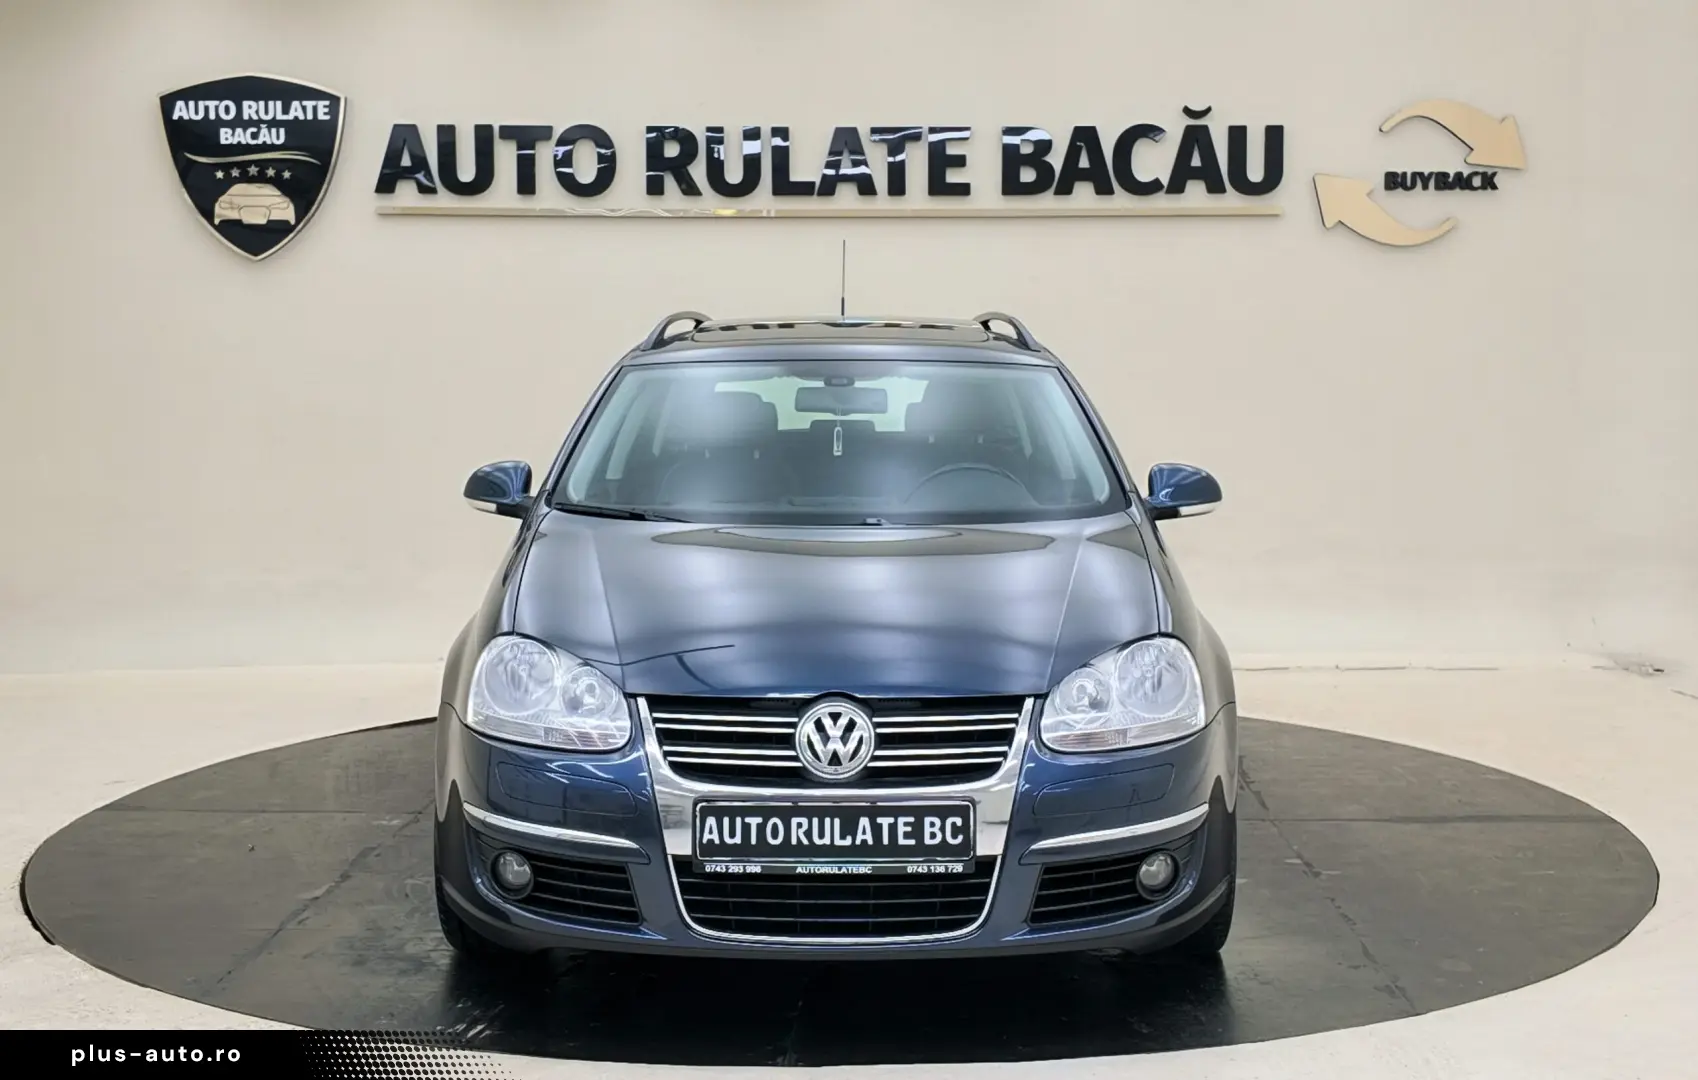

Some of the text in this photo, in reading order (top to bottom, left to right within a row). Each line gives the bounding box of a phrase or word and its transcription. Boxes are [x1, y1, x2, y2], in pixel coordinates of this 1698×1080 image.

[172, 100, 331, 120] AUTO RULATE
[219, 123, 286, 145] BACĂU
[374, 105, 1284, 197] AUTO RULATE BACĂU
[1384, 171, 1499, 191] BUYBACK
[804, 708, 868, 769] VW
[702, 816, 964, 846] AUTO RULATE BC
[705, 864, 726, 873] 0743
[727, 865, 744, 873] 293
[795, 866, 873, 874] AUTORULATEBC
[907, 865, 928, 873] 0743
